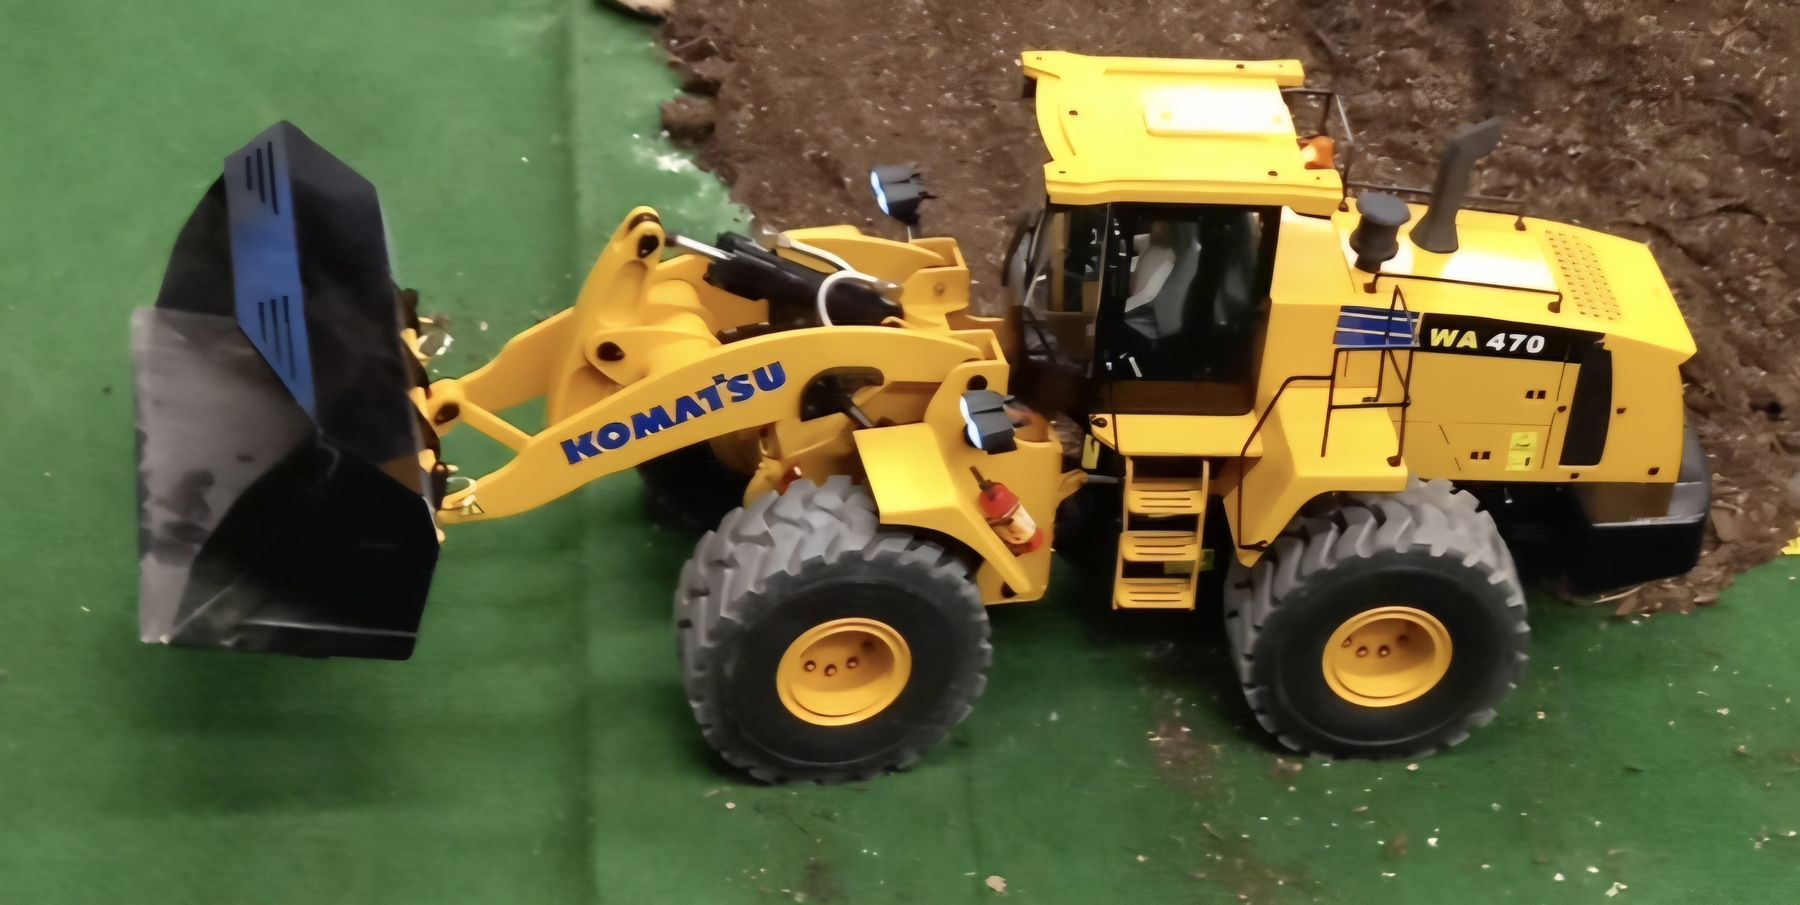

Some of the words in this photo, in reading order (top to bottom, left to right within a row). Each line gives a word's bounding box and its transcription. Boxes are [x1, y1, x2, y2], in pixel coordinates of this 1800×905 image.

[1430, 328, 1477, 349] WA
[1485, 332, 1545, 354] 470
[560, 361, 786, 464] KOMATSU
